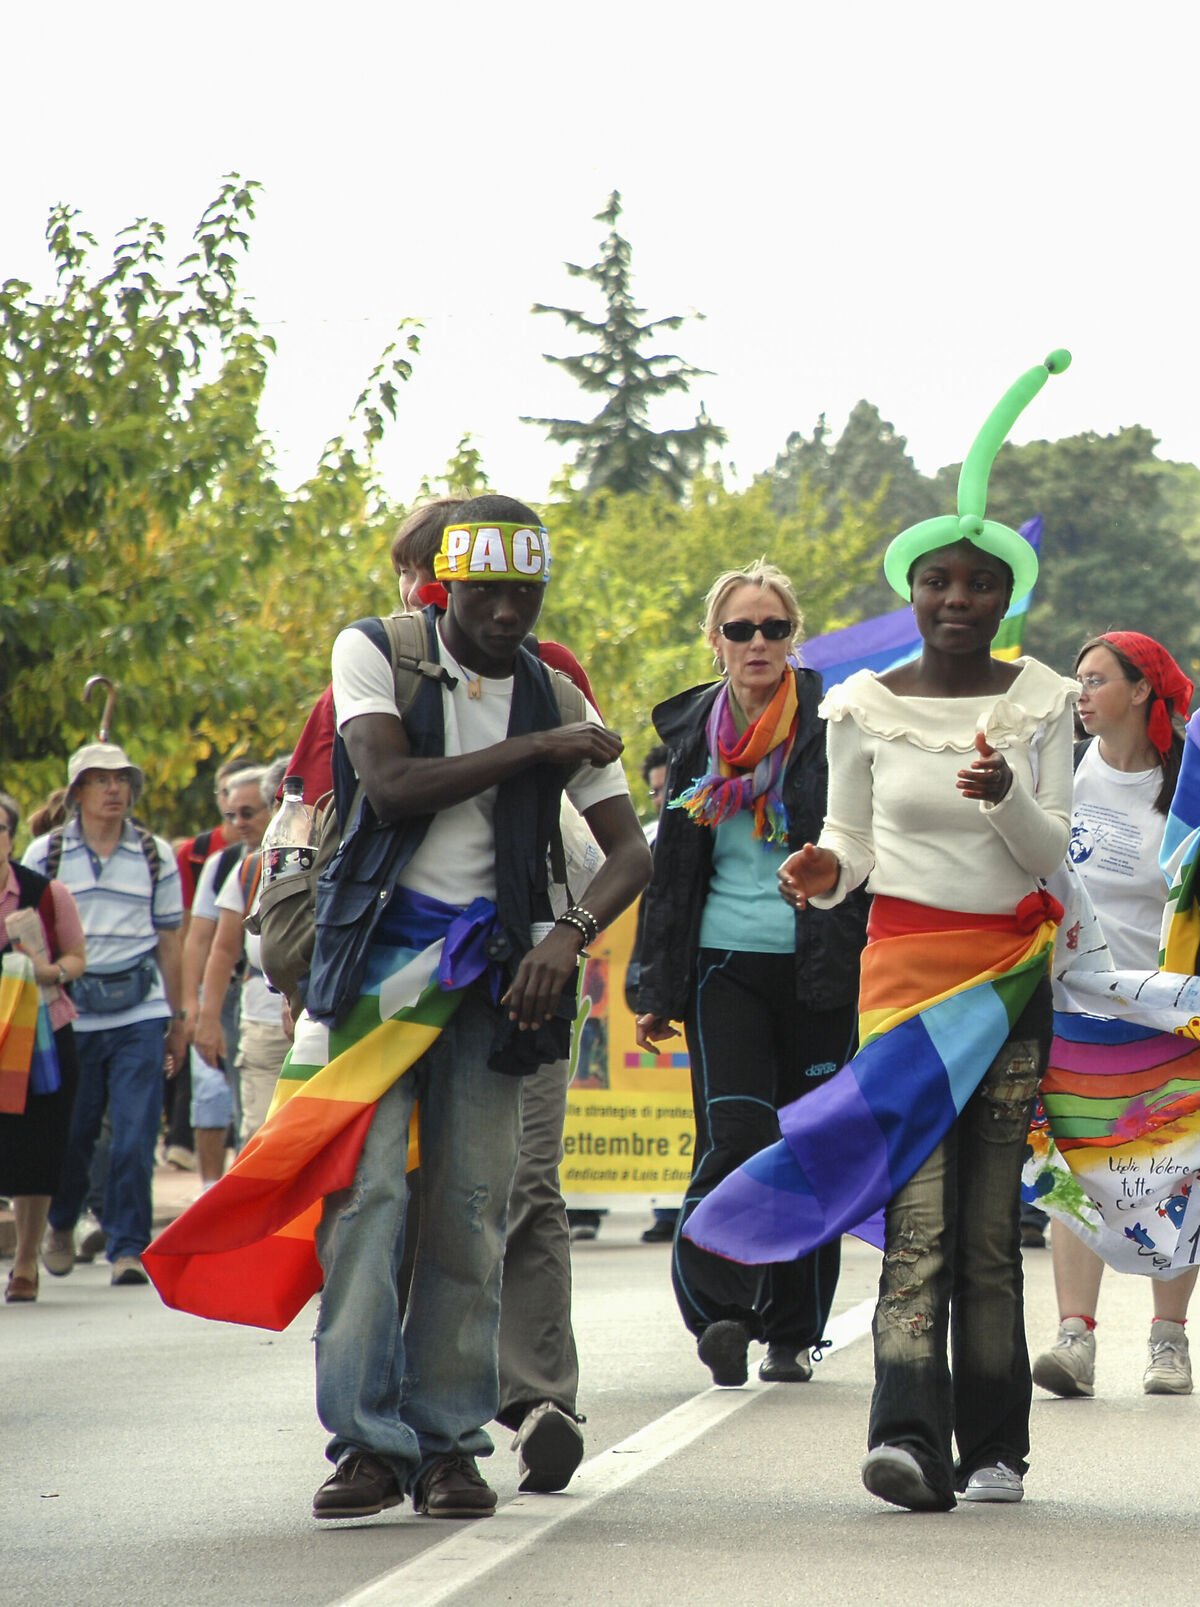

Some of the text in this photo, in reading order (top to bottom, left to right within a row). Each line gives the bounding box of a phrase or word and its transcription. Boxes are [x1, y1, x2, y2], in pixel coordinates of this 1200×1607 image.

[585, 1105, 638, 1120] strategie
[642, 1105, 652, 1116] di
[565, 1168, 618, 1180] dedicato
[633, 1168, 658, 1180] Luis
